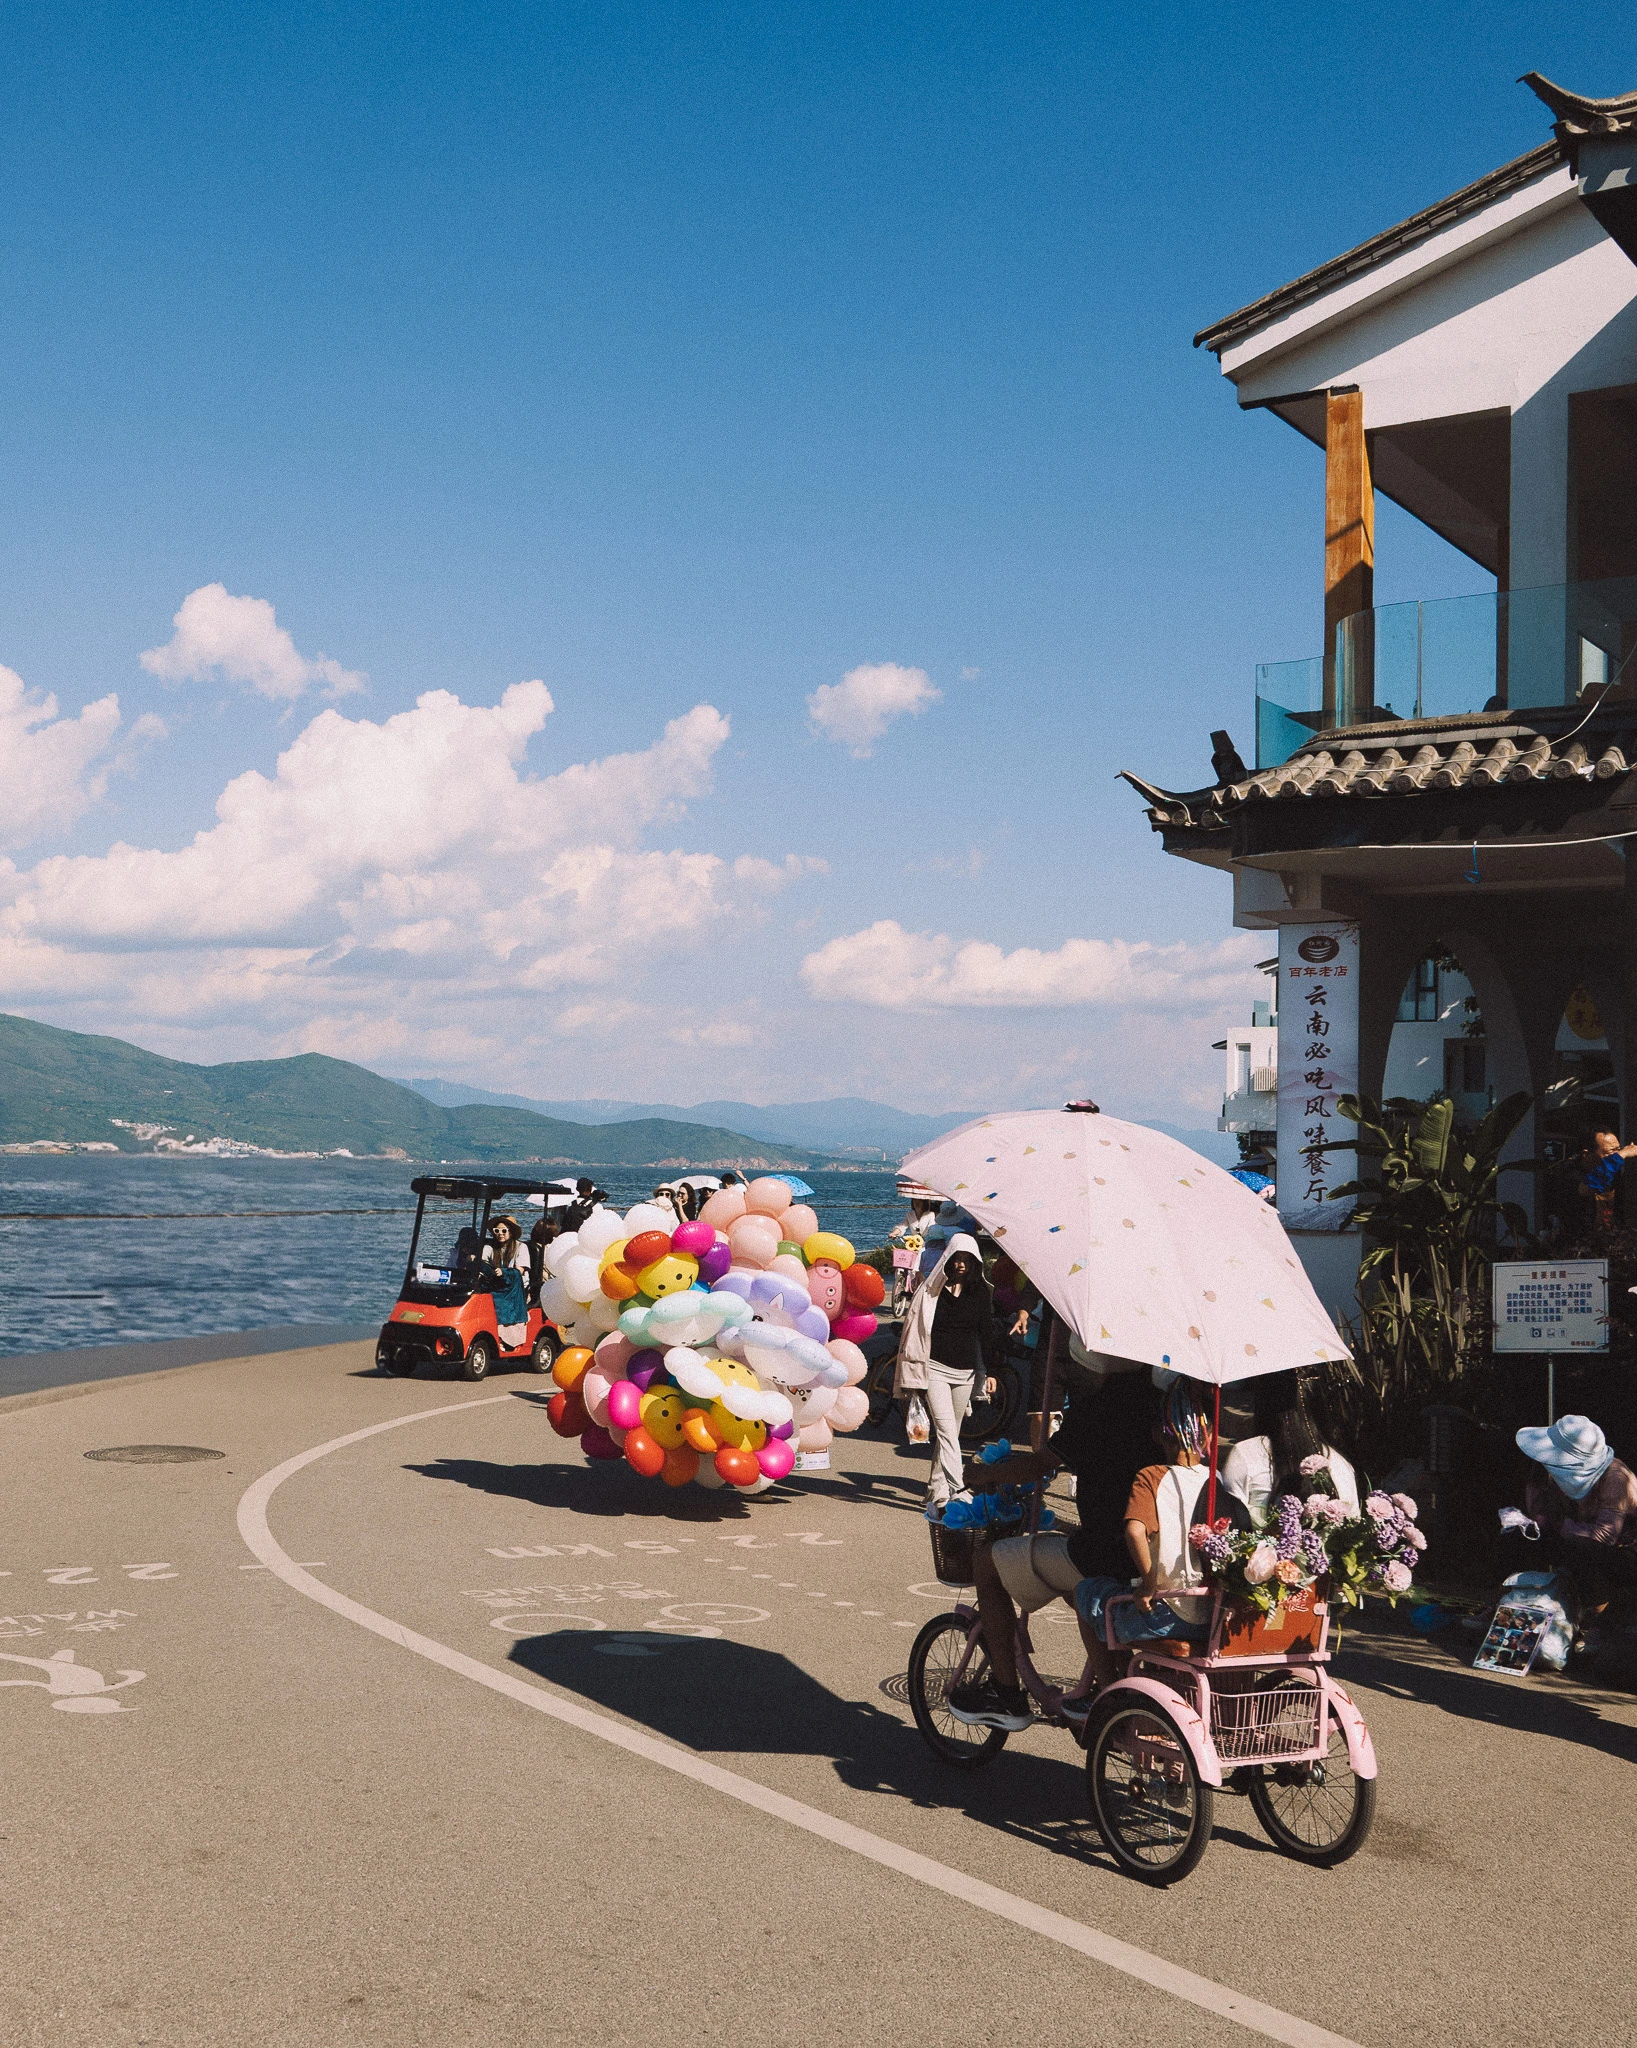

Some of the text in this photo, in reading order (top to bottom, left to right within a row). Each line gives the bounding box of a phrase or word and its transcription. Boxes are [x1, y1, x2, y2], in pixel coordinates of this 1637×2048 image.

[1288, 965, 1349, 978] 百年老店
[1302, 985, 1333, 1204] 云南必吃风味餐厅
[459, 1581, 644, 1598] CYCLING
